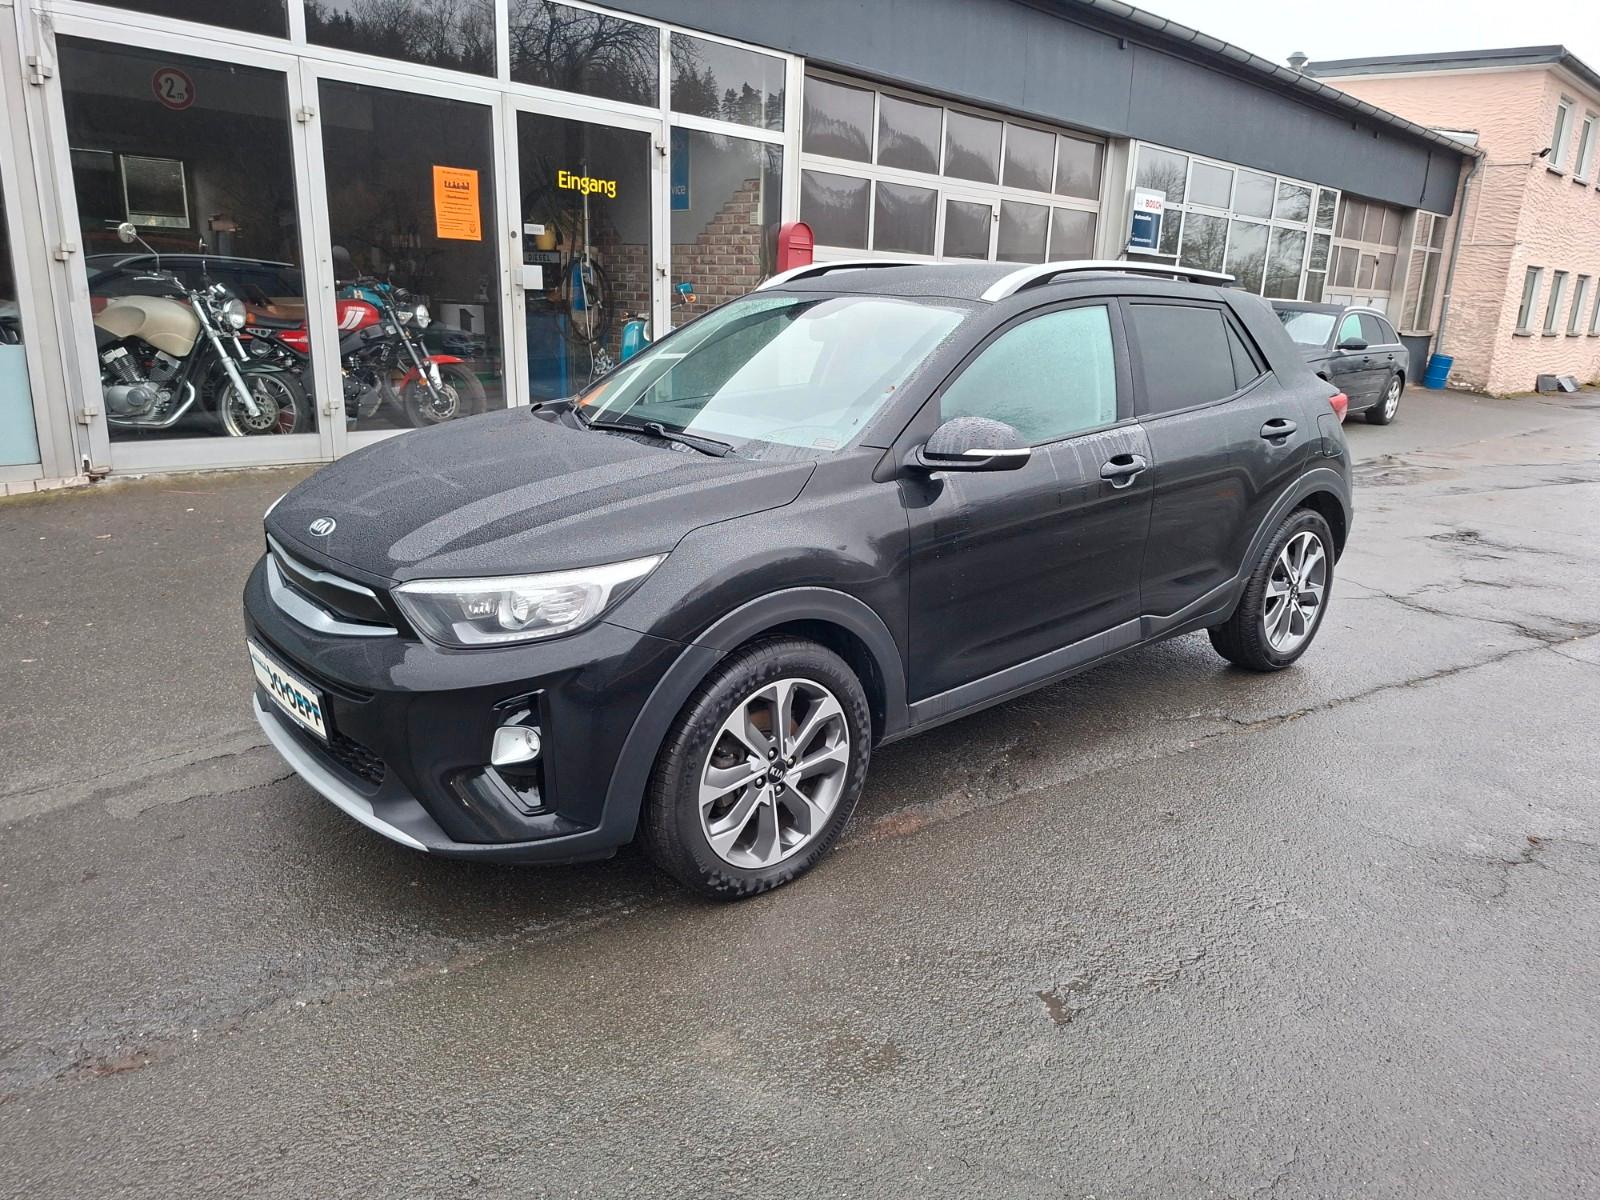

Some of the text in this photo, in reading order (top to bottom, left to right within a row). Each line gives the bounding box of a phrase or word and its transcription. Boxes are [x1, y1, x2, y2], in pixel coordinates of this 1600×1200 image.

[558, 170, 617, 198] Eingang
[1145, 199, 1162, 210] BOSCH
[769, 766, 784, 778] KIA
